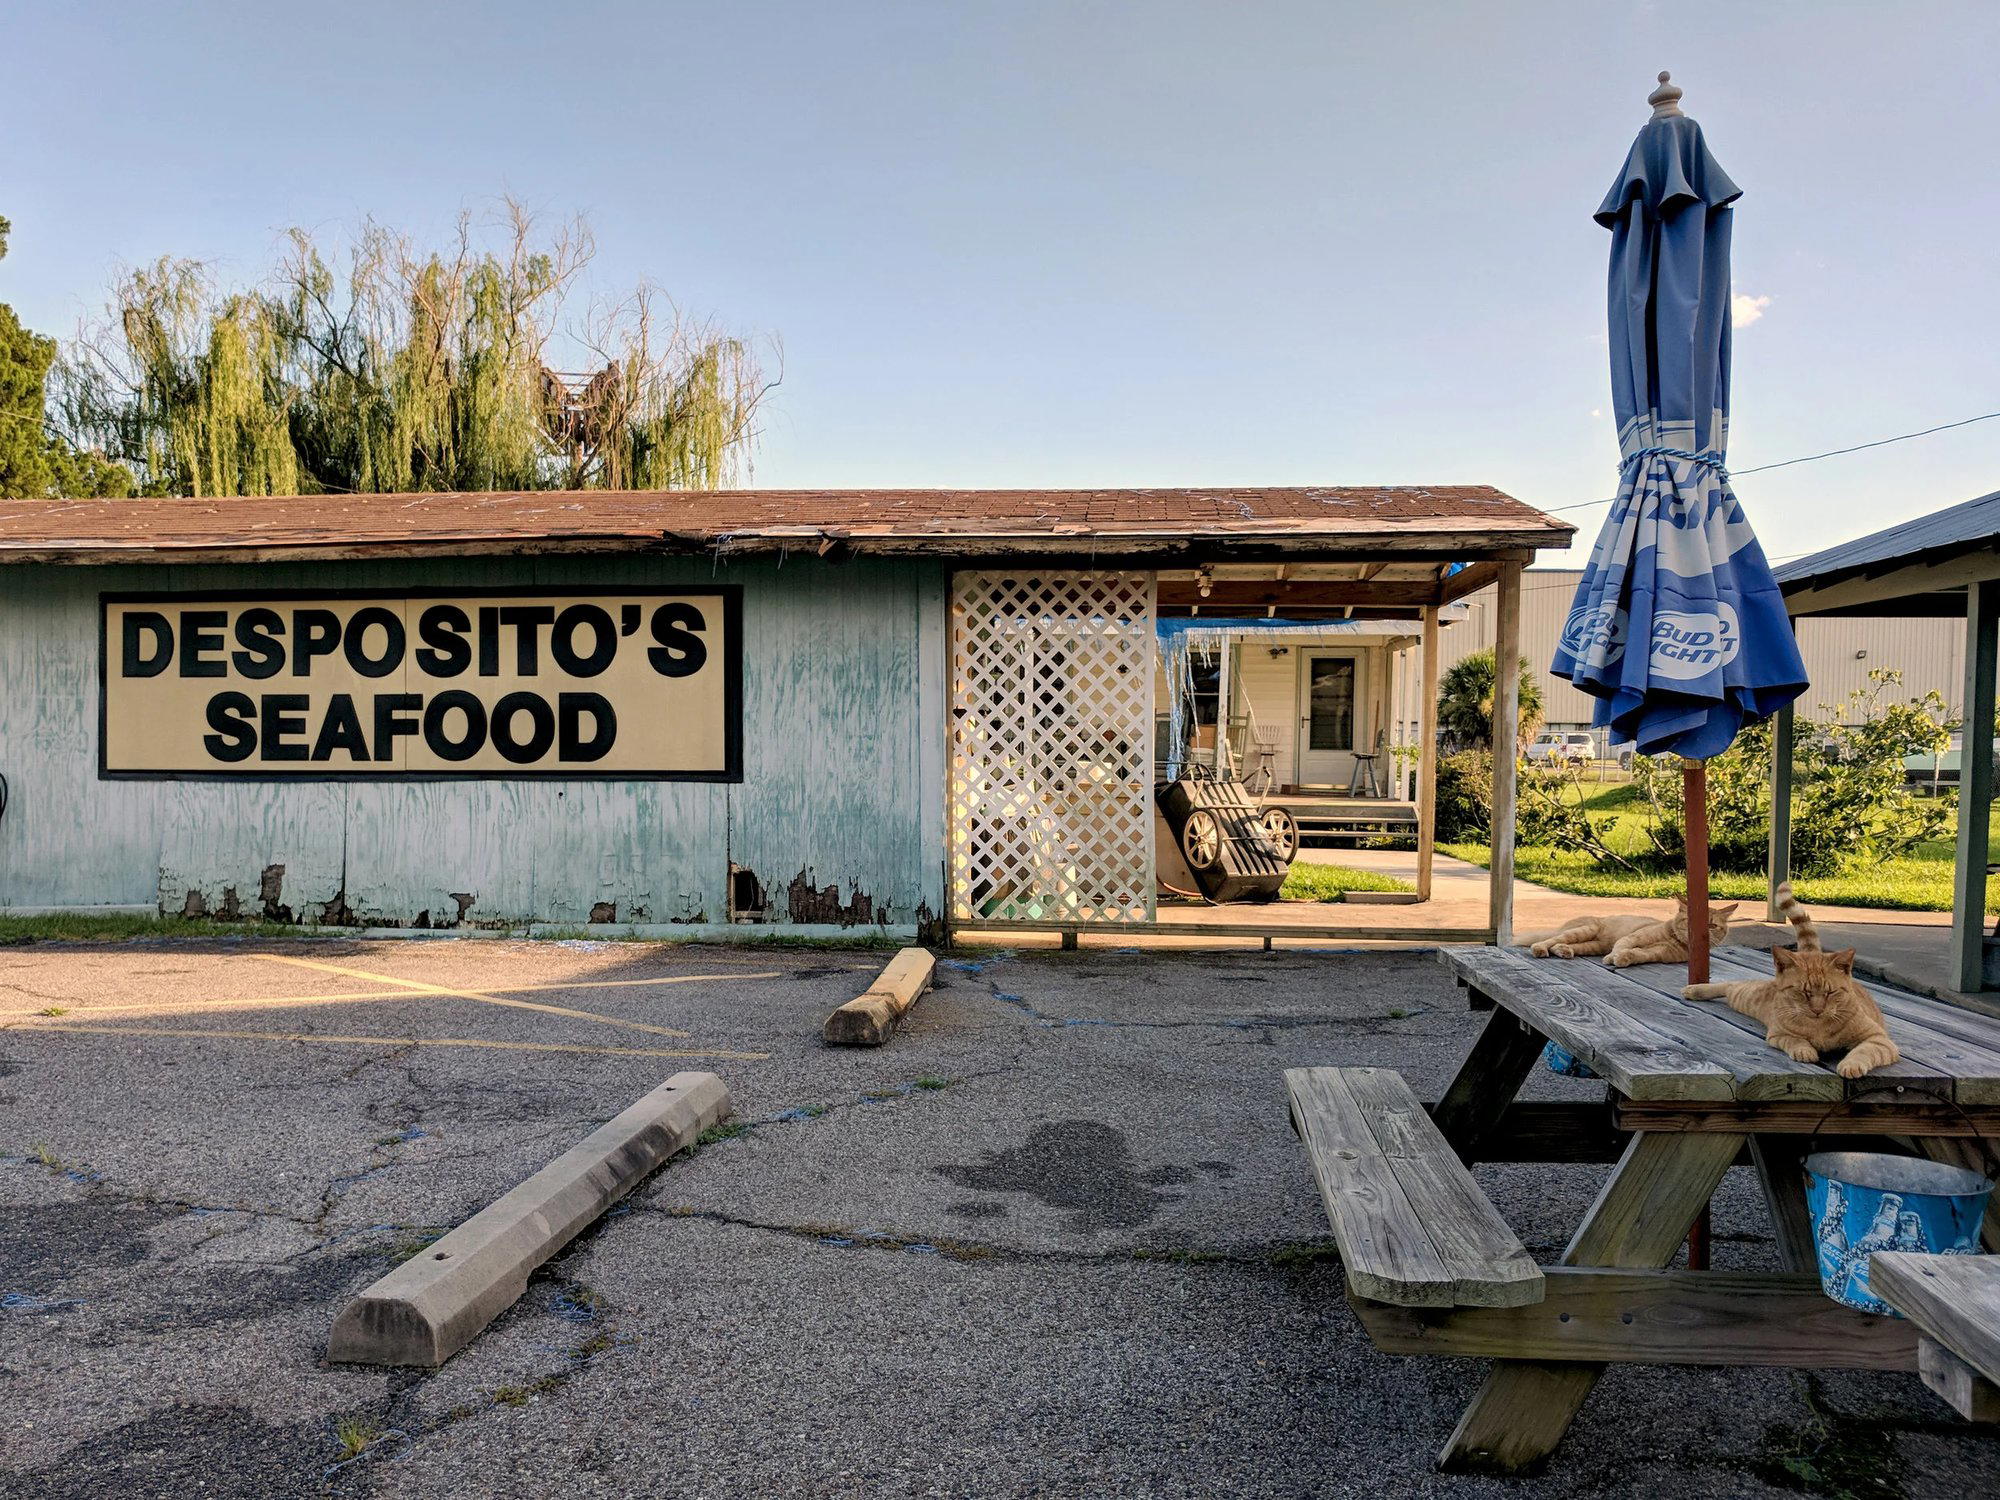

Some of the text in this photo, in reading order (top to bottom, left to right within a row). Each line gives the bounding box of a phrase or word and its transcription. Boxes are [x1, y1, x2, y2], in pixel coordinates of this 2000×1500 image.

[121, 602, 708, 680] DESPOSITO'S
[1650, 640, 1720, 664] IGHT
[203, 689, 618, 765] SEAFOOD
